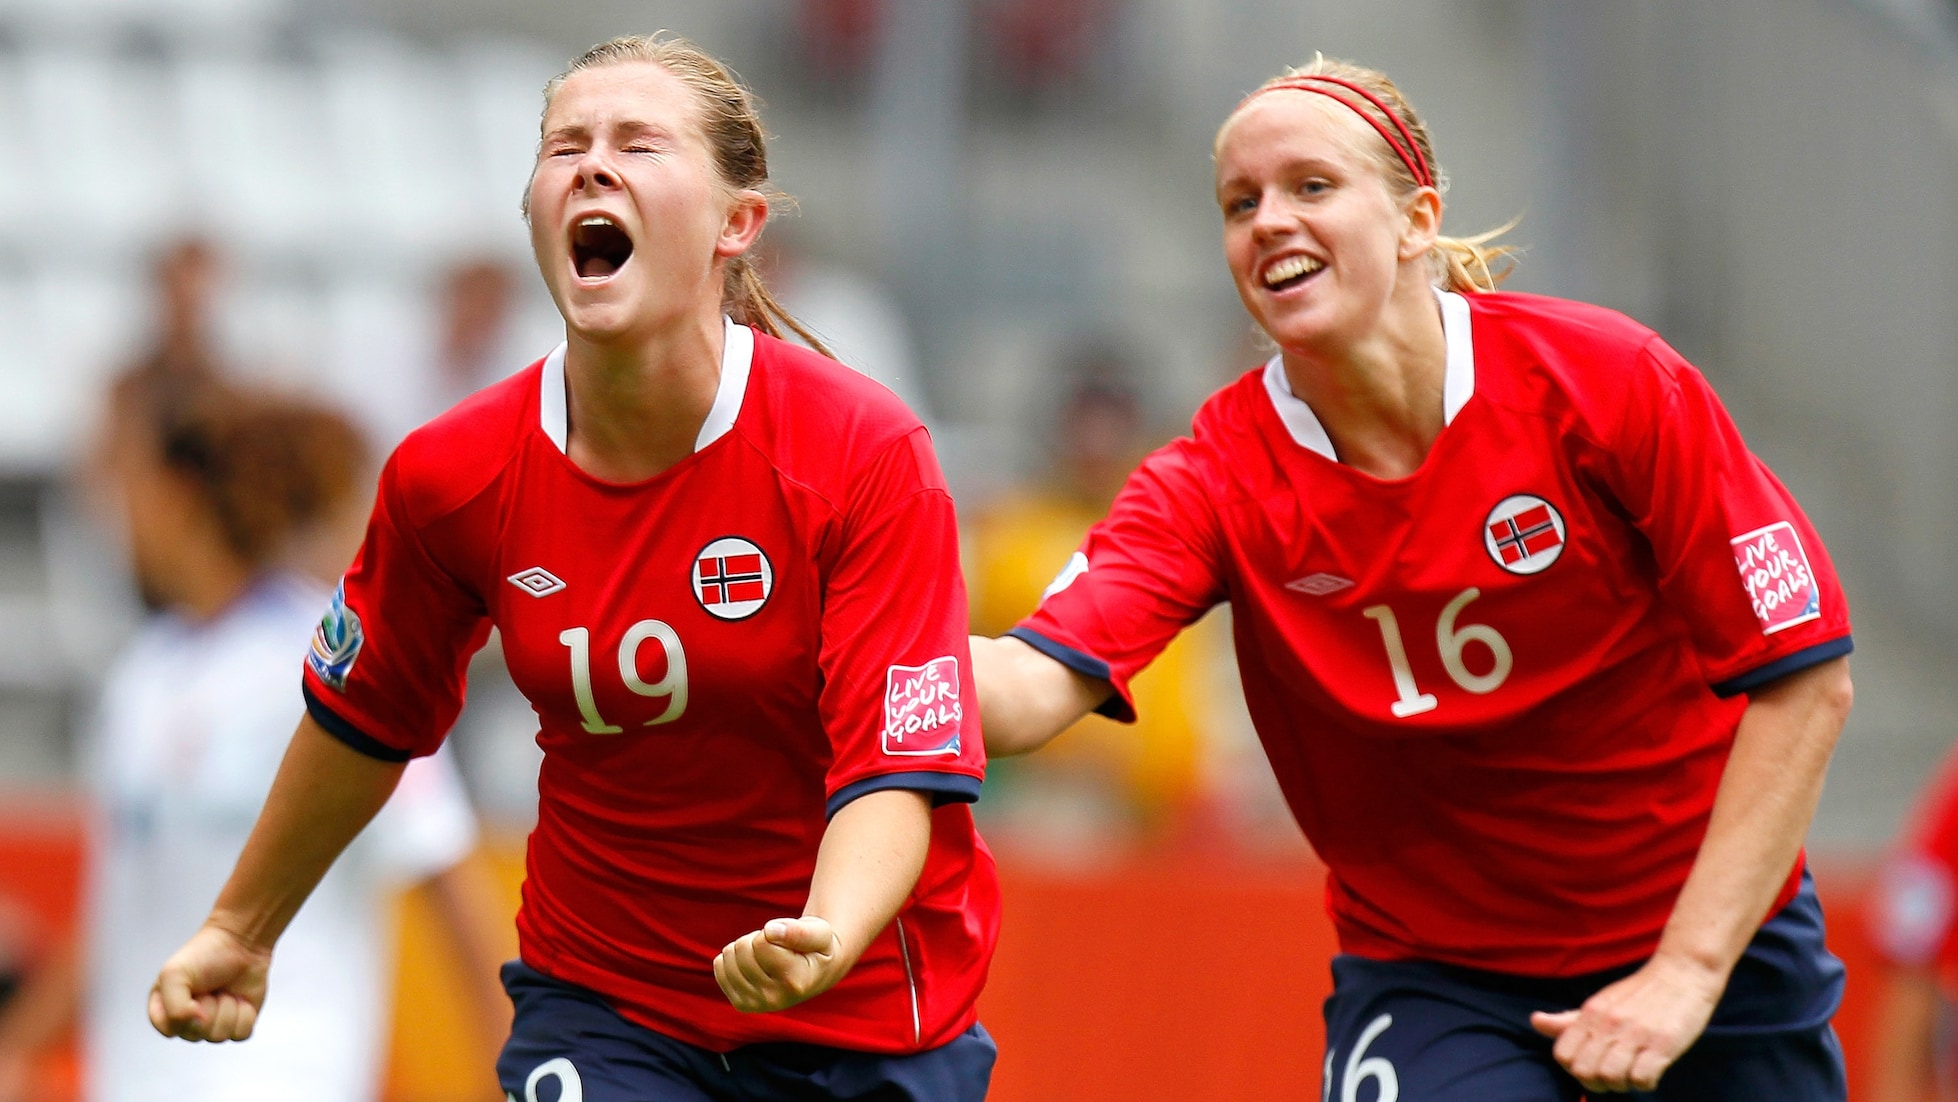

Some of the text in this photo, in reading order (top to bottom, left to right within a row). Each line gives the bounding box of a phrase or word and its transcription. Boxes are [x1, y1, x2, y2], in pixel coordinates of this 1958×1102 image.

[1735, 531, 1779, 576] LIVE
[1743, 549, 1798, 599] YOUR
[1752, 564, 1809, 622] GOALS
[1363, 586, 1514, 718] 16
[559, 618, 689, 735] 19
[890, 664, 941, 703] LIVE
[888, 701, 963, 743] GOALS
[891, 681, 958, 720] YOUR
